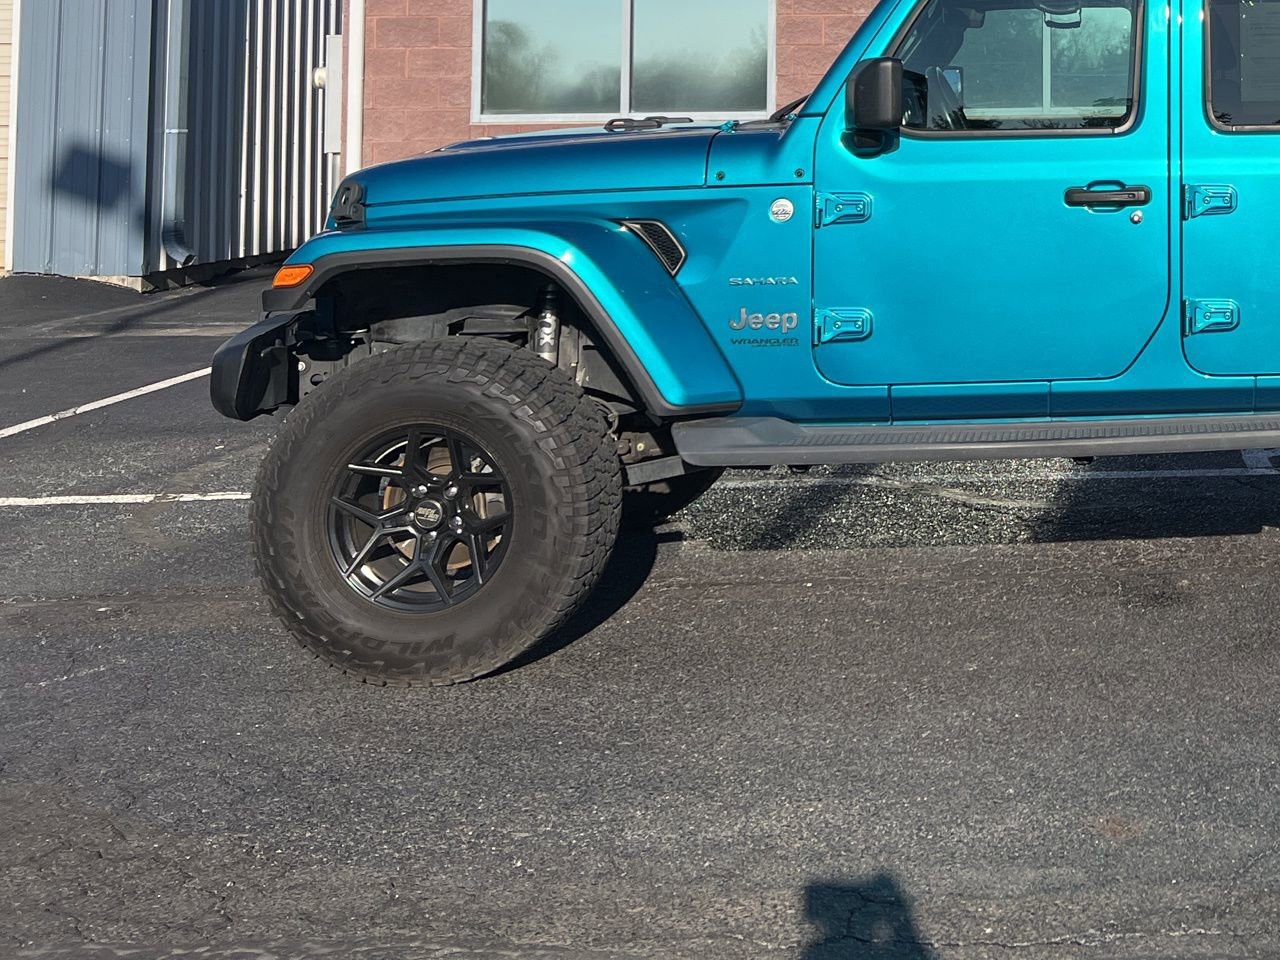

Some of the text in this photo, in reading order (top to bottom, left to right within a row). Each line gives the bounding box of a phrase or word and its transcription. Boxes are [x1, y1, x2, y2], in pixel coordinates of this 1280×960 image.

[729, 276, 799, 286] SAHARA
[729, 307, 799, 334] Jeep
[730, 337, 799, 345] WRANGLER
